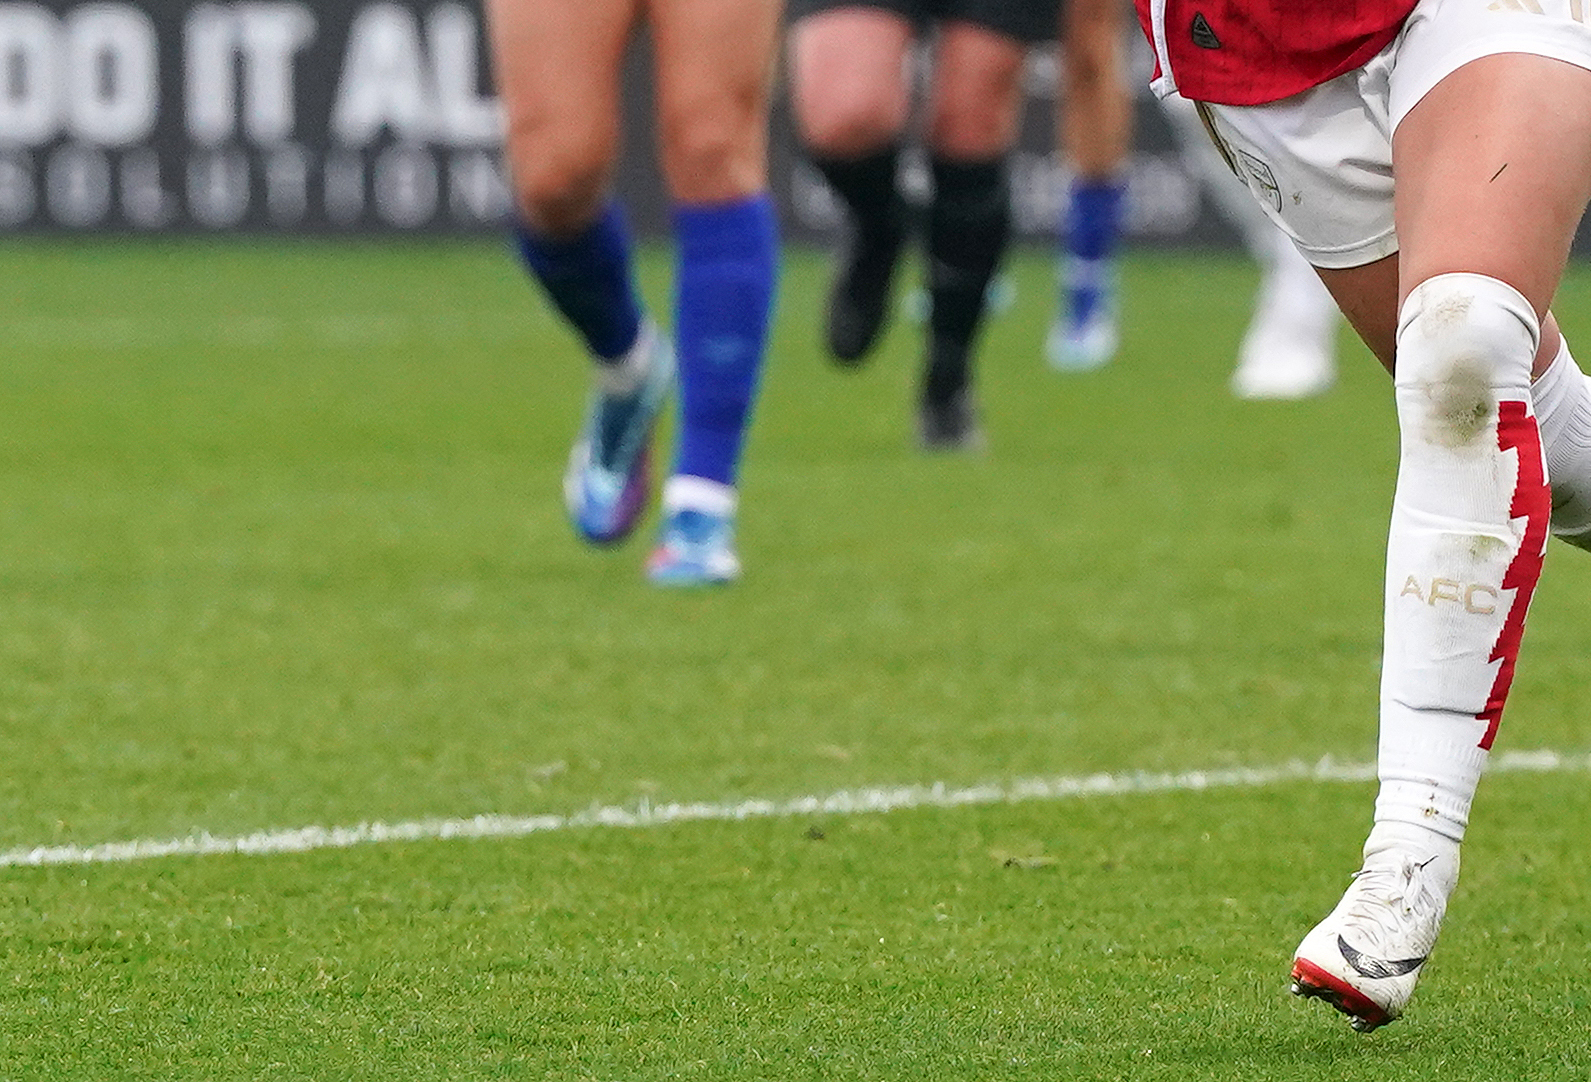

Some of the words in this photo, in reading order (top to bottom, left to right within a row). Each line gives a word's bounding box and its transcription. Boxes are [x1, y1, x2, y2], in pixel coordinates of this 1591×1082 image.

[183, 0, 319, 148] IT
[330, 0, 511, 147] AL
[0, 146, 514, 228] SOLUTION
[1401, 574, 1499, 615] AFC
